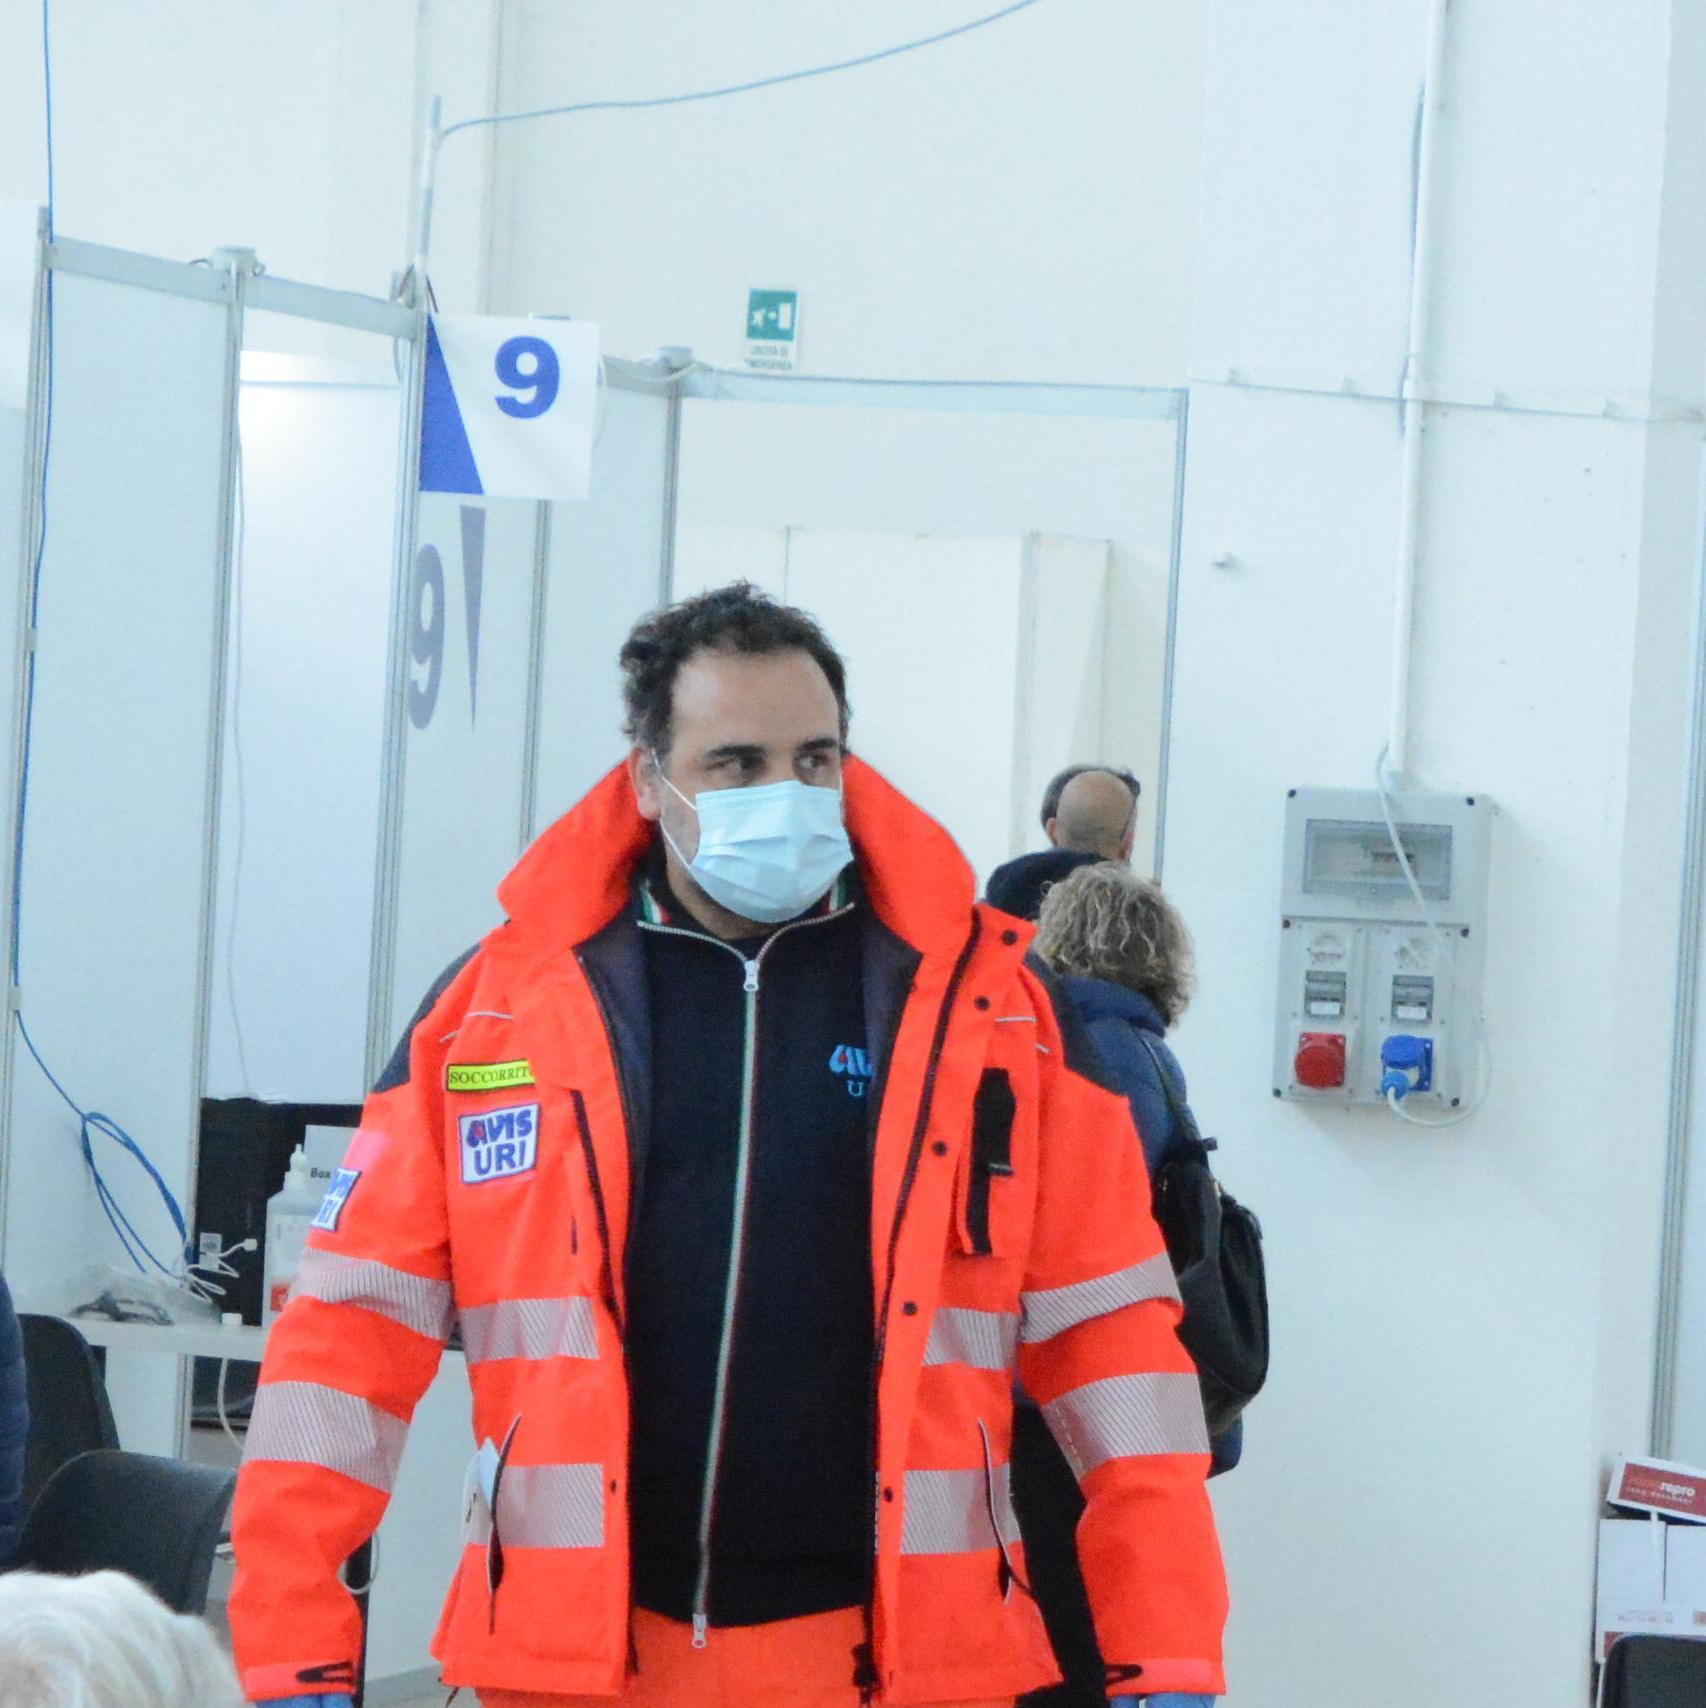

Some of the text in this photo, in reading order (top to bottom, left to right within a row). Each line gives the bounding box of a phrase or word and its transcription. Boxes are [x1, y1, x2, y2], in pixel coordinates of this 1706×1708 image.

[495, 336, 560, 419] 9
[408, 543, 445, 730] 9
[450, 1066, 534, 1085] SOCCORRIT
[466, 1108, 532, 1148] AVIS
[474, 1141, 527, 1176] URI
